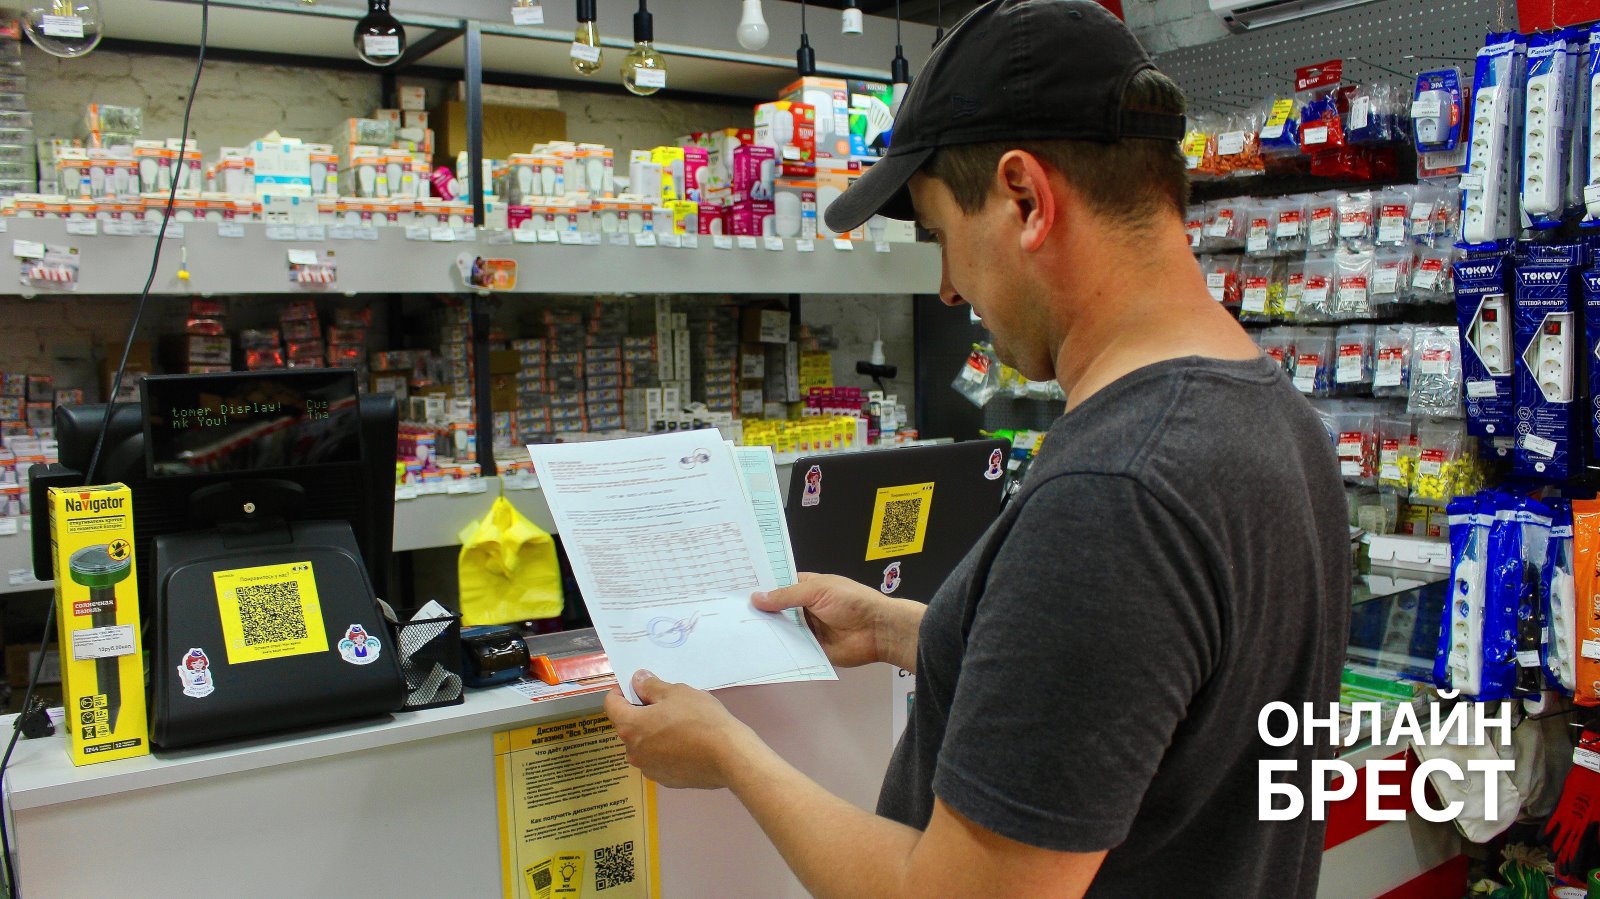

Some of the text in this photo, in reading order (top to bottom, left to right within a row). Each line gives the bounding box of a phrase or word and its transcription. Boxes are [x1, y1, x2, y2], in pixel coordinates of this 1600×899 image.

[1459, 265, 1494, 276] TOKOV
[1522, 272, 1560, 280] TOKOV
[172, 400, 328, 418] tomer Display! Cus
[173, 410, 329, 428] nk You! Tha
[66, 496, 124, 513] Navigator
[74, 600, 114, 608] солнечная
[532, 734, 564, 744] магазина
[583, 724, 614, 735] Электрик
[536, 722, 576, 736] Дисконтная
[548, 747, 561, 755] даёт
[562, 740, 598, 752] дисконтная
[598, 736, 618, 744] карта?
[543, 812, 572, 822] получить
[572, 803, 608, 816] дисконтную
[609, 798, 629, 808] карту?
